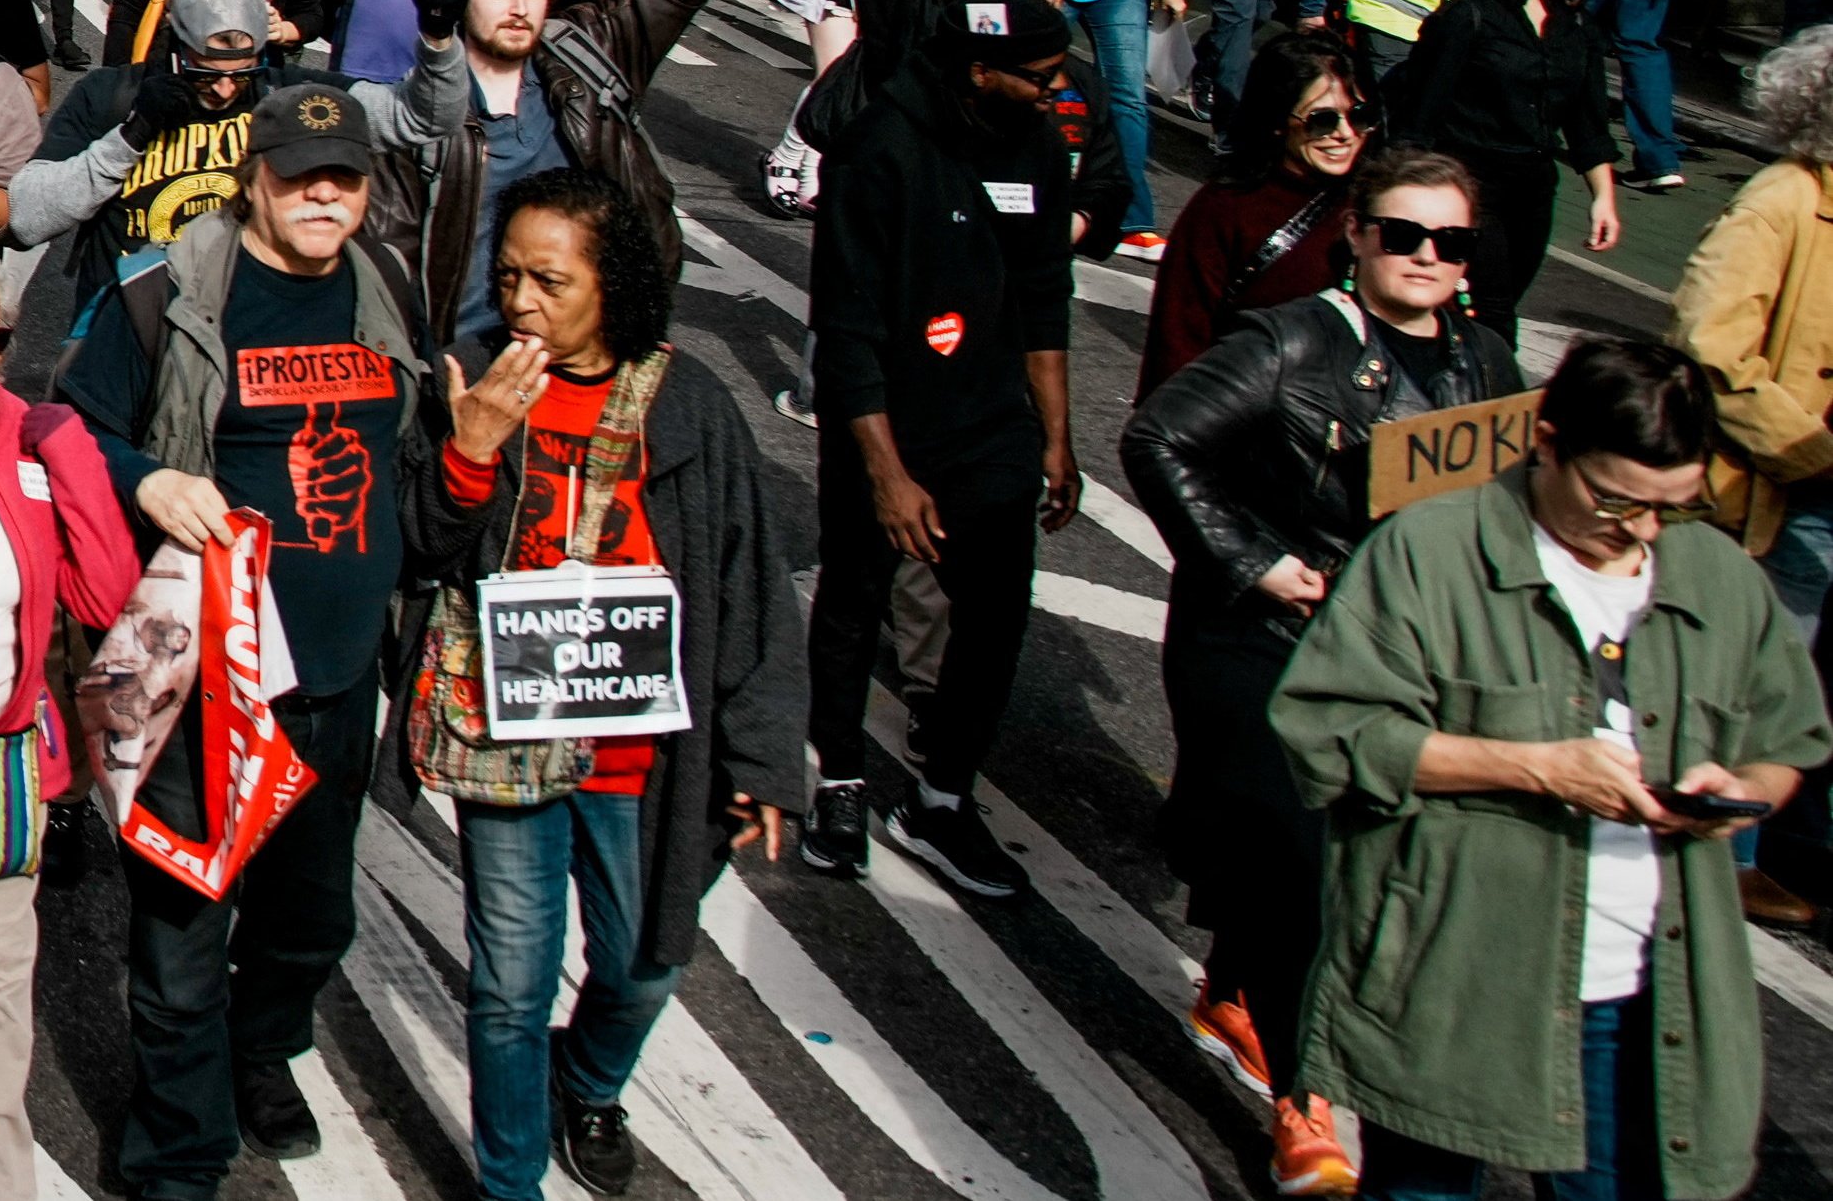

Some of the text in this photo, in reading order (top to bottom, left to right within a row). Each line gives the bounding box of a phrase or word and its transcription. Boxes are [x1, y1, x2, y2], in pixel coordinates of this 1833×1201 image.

[927, 331, 961, 346] TRUMP
[933, 318, 958, 331] HATE
[1407, 410, 1531, 483] NO KI
[496, 606, 668, 636] HANDS OFF
[553, 640, 623, 674] OUR
[501, 673, 670, 705] HEALTHCARE
